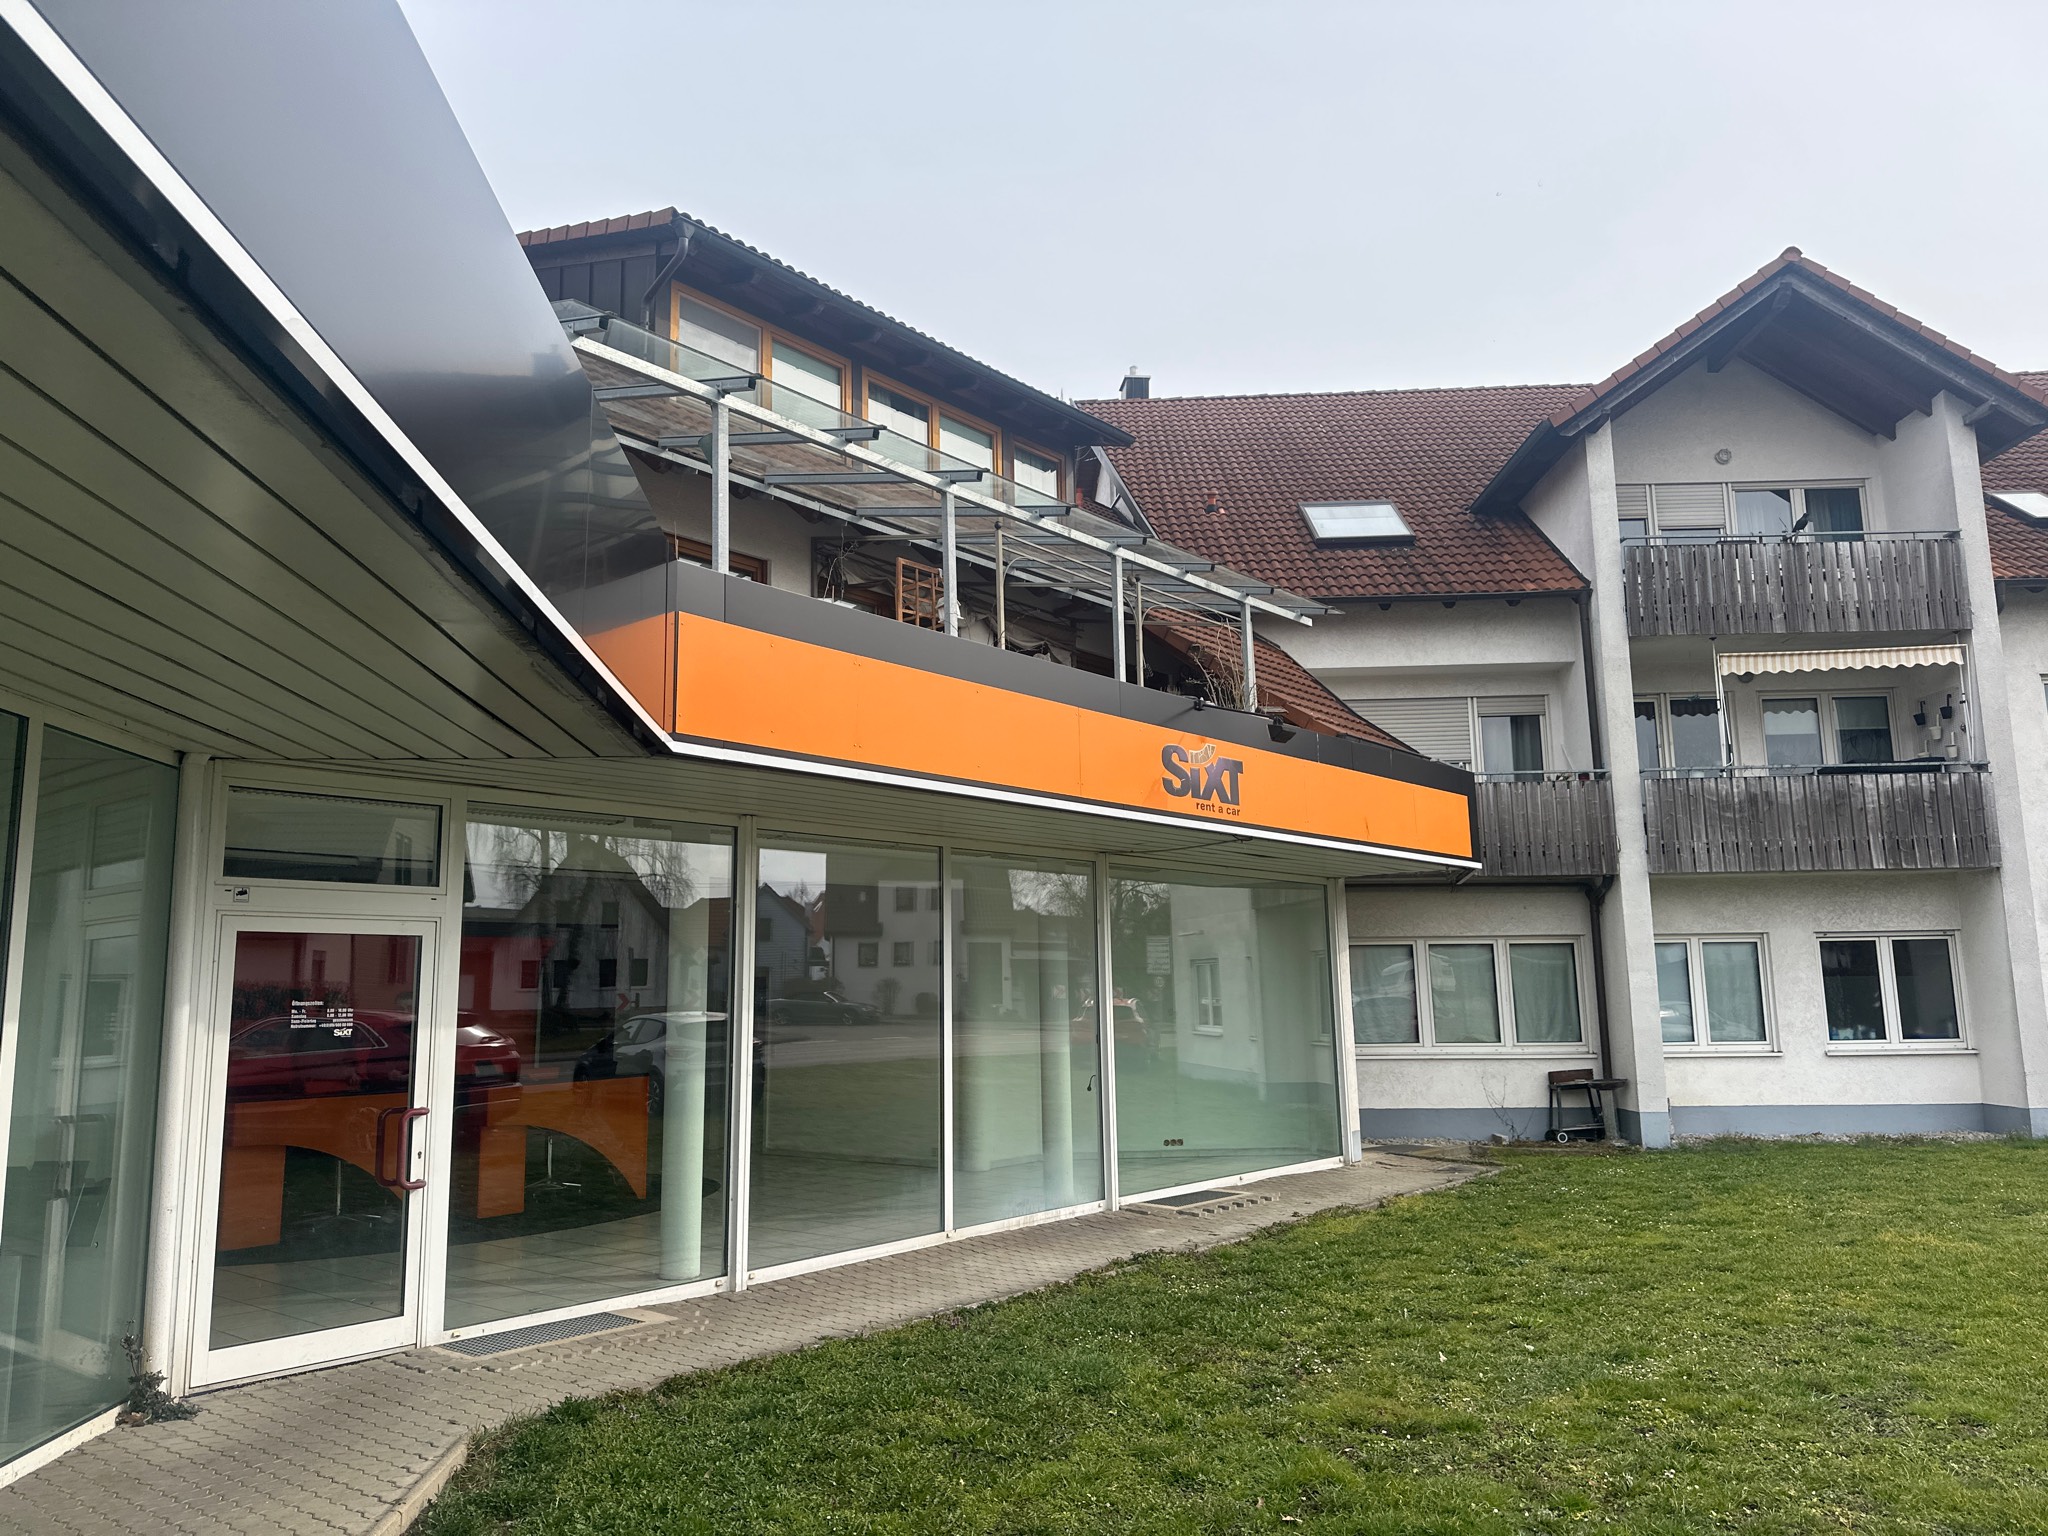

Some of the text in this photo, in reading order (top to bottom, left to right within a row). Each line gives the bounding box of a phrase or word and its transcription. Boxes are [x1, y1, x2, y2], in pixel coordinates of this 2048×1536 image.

[1196, 802, 1241, 816] rent a car
